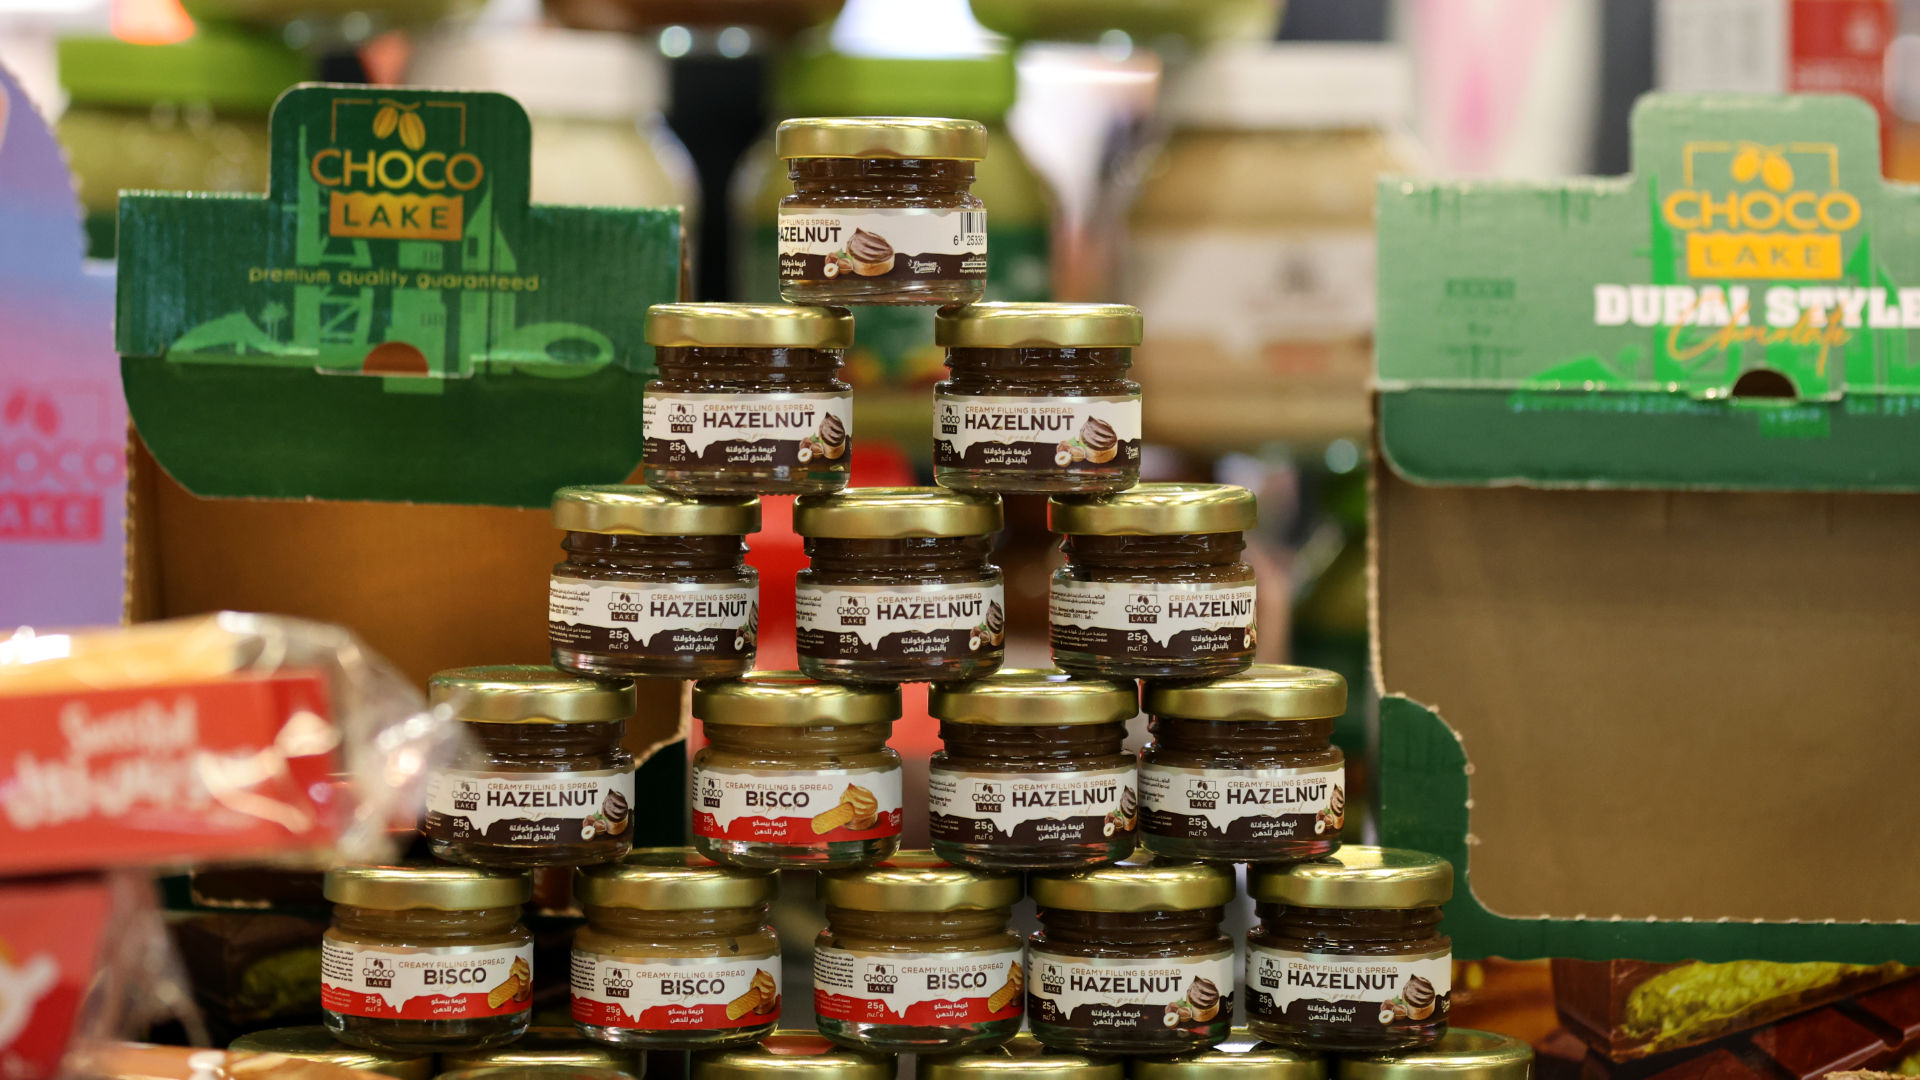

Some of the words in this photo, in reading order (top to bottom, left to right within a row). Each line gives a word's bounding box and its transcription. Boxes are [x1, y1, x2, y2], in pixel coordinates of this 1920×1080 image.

[312, 149, 484, 191] CHOCO
[1662, 190, 1861, 231] CHOCO
[344, 205, 449, 230] LAKE
[953, 235, 959, 246] 6
[1706, 245, 1822, 268] LAKE
[249, 267, 330, 284] premium
[338, 268, 408, 288] quality
[416, 272, 540, 291] guaranteed
[1594, 284, 1750, 327] DUBAI
[1765, 285, 1920, 329] STYLE
[965, 406, 995, 414] CREAMY
[668, 414, 697, 423] CHOCO
[703, 412, 815, 428] HAZELNUT
[965, 414, 1074, 430] HAZELNUT
[669, 443, 686, 454] 25g
[0, 438, 127, 489] OCO
[0, 503, 88, 531] AKE
[651, 593, 686, 601] CREAMY
[689, 593, 718, 601] FILLING
[916, 595, 948, 603] FILLING
[1169, 594, 1203, 602] CREAMY
[1205, 593, 1230, 601] FILLING
[608, 602, 643, 612] CHOCO
[650, 601, 747, 617] HAZELNUT
[837, 607, 870, 615] CHOCO
[877, 600, 982, 620] HAZELNUT
[1125, 605, 1161, 613] CHOCO
[1169, 599, 1252, 618] HAZELNUT
[609, 630, 629, 642] 25g
[839, 635, 859, 646] 25g
[1127, 633, 1148, 644] 25g
[725, 782, 755, 790] CREAMY
[1050, 782, 1081, 790] FILLING
[1266, 779, 1294, 788] FILLING
[487, 789, 598, 807] HAZELNUT
[746, 791, 809, 807] BISCO
[972, 793, 1005, 802] CHOCO
[1012, 786, 1117, 807] HAZELNUT
[1186, 790, 1220, 799] CHOCO
[1227, 784, 1327, 804] HAZELNUT
[453, 818, 470, 831] 25g
[974, 821, 993, 833] 25g
[1188, 817, 1208, 829] 25g
[399, 961, 434, 969] CREAMY
[1289, 962, 1320, 971] CREAMY
[1323, 966, 1354, 974] FILLING
[1365, 966, 1398, 974] SPREAD
[362, 968, 395, 978] CHOCO
[424, 967, 487, 985] BISCO
[636, 971, 671, 979] CREAMY
[864, 974, 898, 984] CHOCO
[1148, 969, 1181, 977] SPREAD
[603, 978, 633, 988] CHOCO
[927, 972, 987, 990] BISCO
[1071, 975, 1182, 993] HAZELNUT
[1288, 970, 1399, 990] HAZELNUT
[661, 979, 725, 995] BISCO
[365, 996, 382, 1007] 25g
[867, 1002, 884, 1012] 25g
[1259, 994, 1273, 1008] 25g
[606, 1006, 621, 1016] 25g
[1042, 1001, 1056, 1014] 25g
